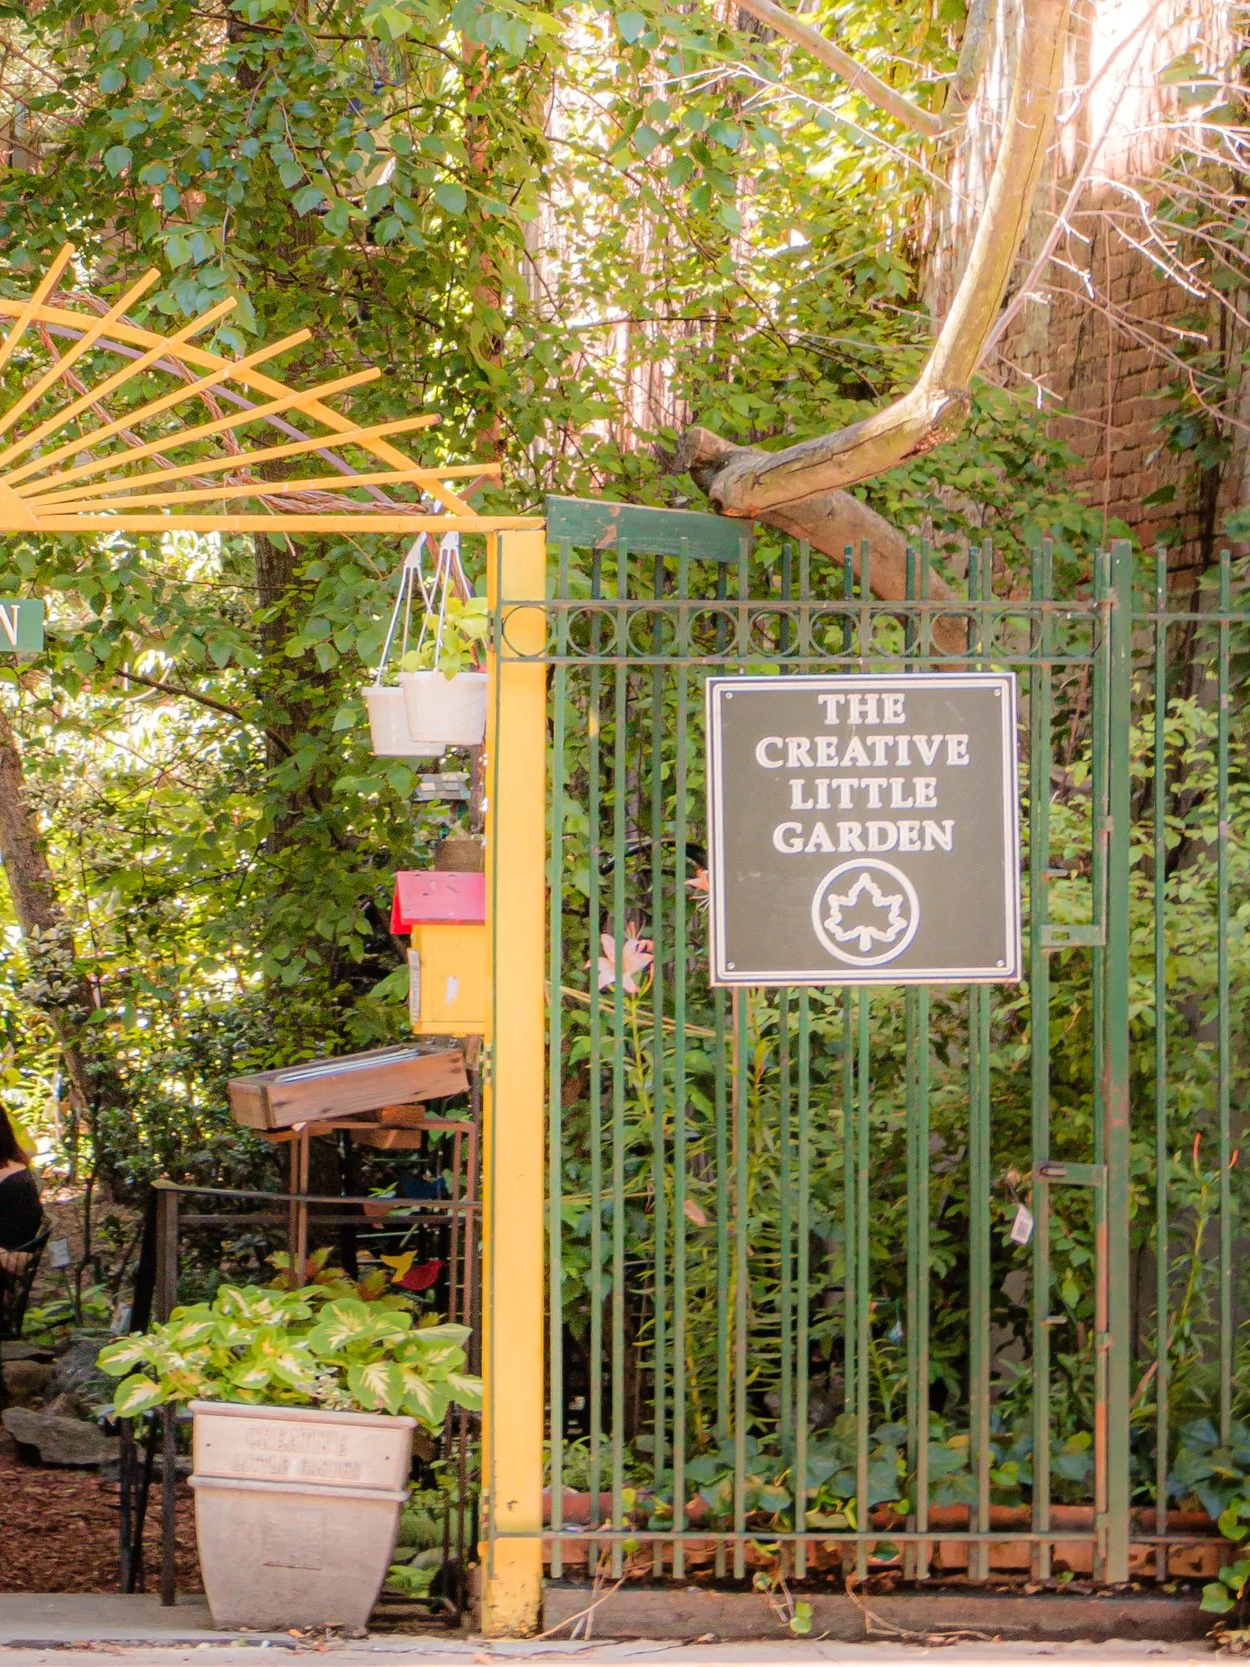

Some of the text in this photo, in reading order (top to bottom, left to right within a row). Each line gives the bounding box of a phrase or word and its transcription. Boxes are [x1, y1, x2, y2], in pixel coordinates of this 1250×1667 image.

[818, 692, 907, 726] THE
[755, 733, 971, 769] CREATIVE
[788, 776, 938, 810] LITTLE
[772, 819, 956, 854] GARDEN
